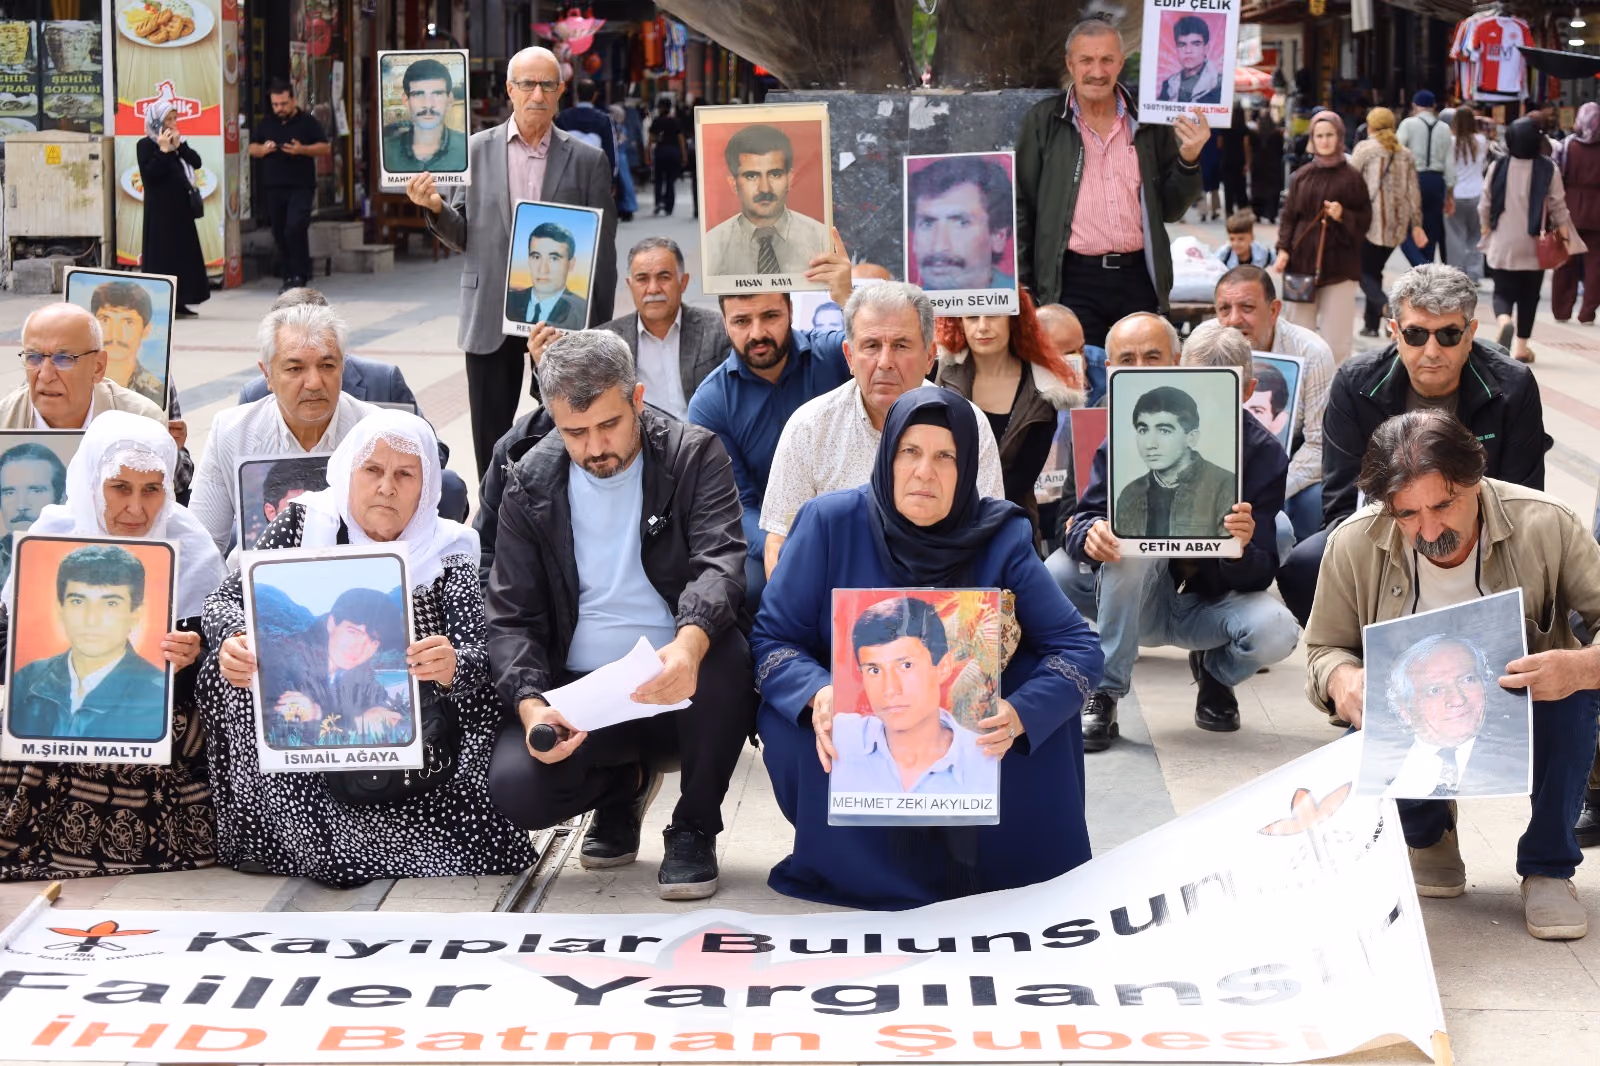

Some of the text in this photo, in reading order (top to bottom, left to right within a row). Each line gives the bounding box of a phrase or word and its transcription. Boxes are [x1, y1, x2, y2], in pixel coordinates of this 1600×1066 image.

[44, 85, 101, 94] SOFRASI
[433, 175, 465, 183] EMİREL
[735, 278, 793, 287] HASAN KAYA
[929, 292, 1009, 309] seyin SEVİM
[1139, 540, 1222, 553] ÇETİN ABAY
[21, 742, 152, 758] M.ŞİRİN MALTU
[284, 750, 400, 764] İSMAİL AĞAYA
[832, 797, 993, 810] MEHMET ZEKİ AKYILDIZ
[185, 869, 1238, 959] Kayıplar Bulunsun
[0, 970, 493, 1010] Failler
[317, 1025, 821, 1051] Batman
[875, 1024, 1329, 1058] Şubesi
